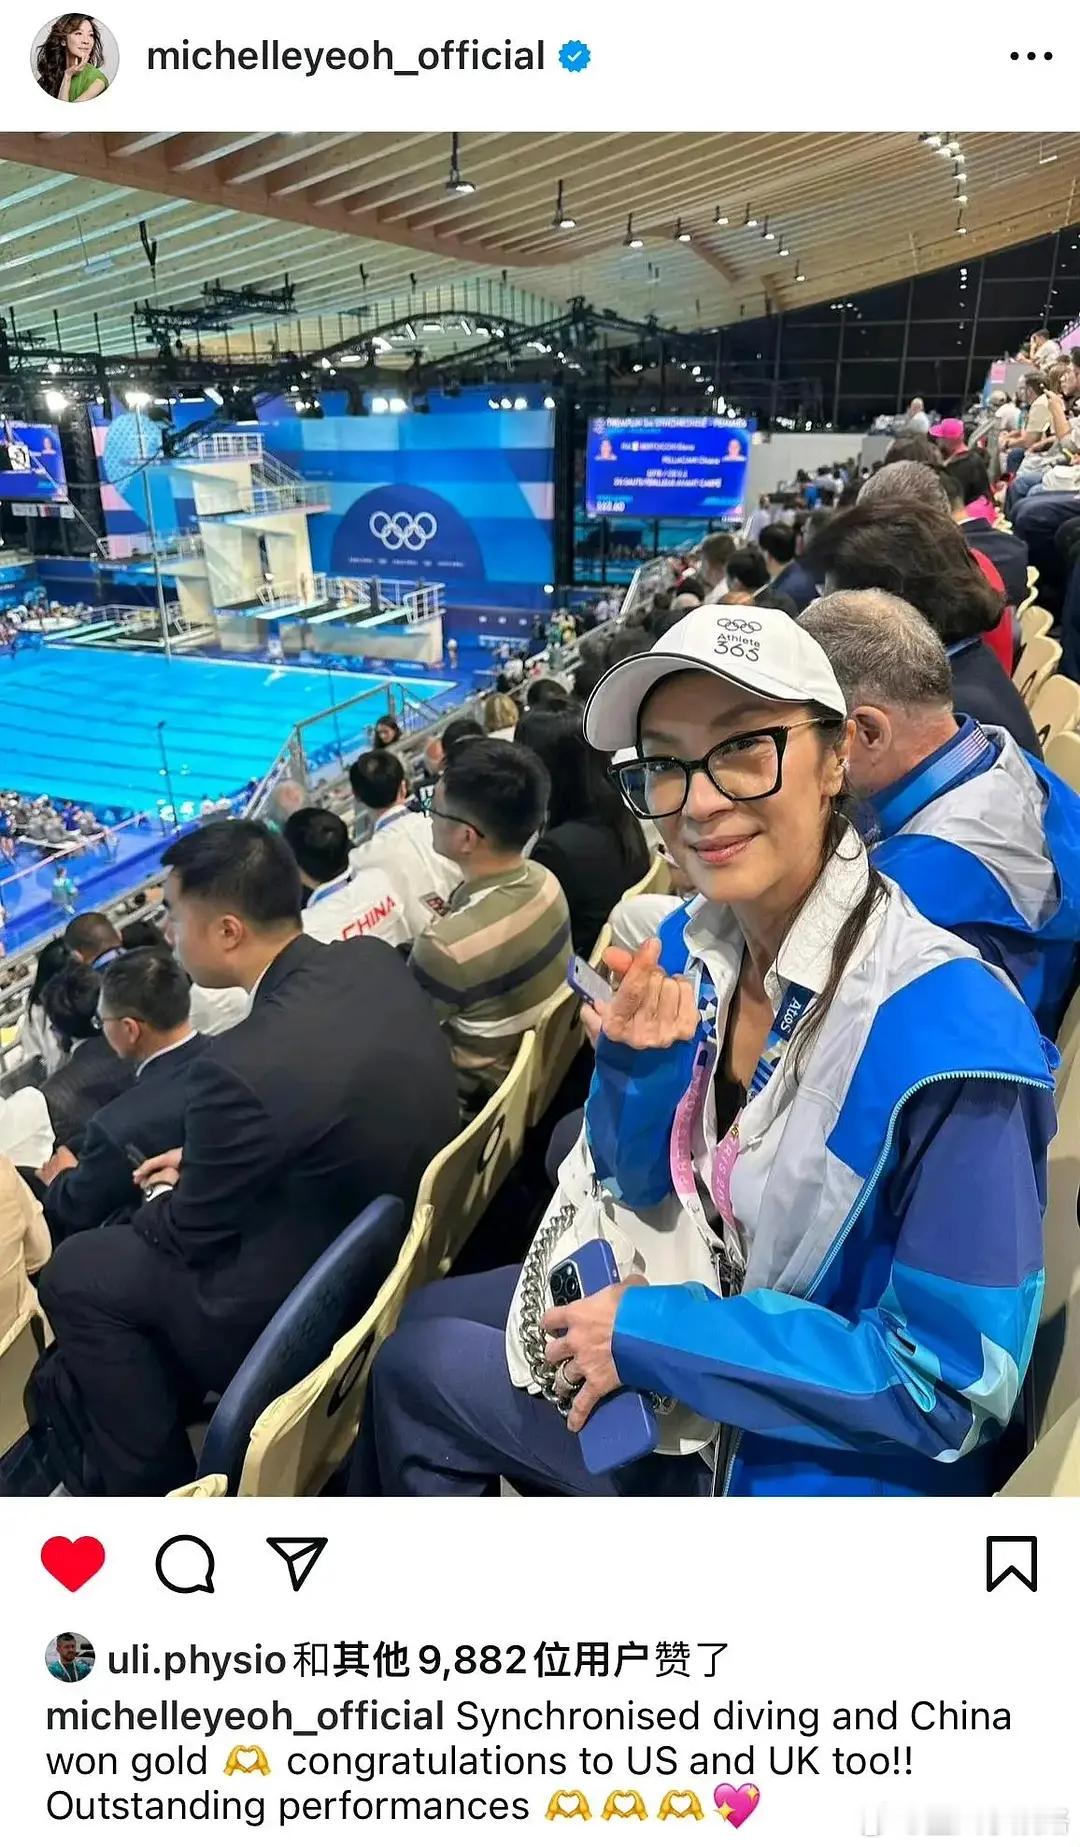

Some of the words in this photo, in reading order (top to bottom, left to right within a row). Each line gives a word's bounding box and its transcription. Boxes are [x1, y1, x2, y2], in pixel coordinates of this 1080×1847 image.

[713, 640, 760, 662] 365
[716, 632, 761, 648] Athlete
[341, 895, 397, 941] CHINA
